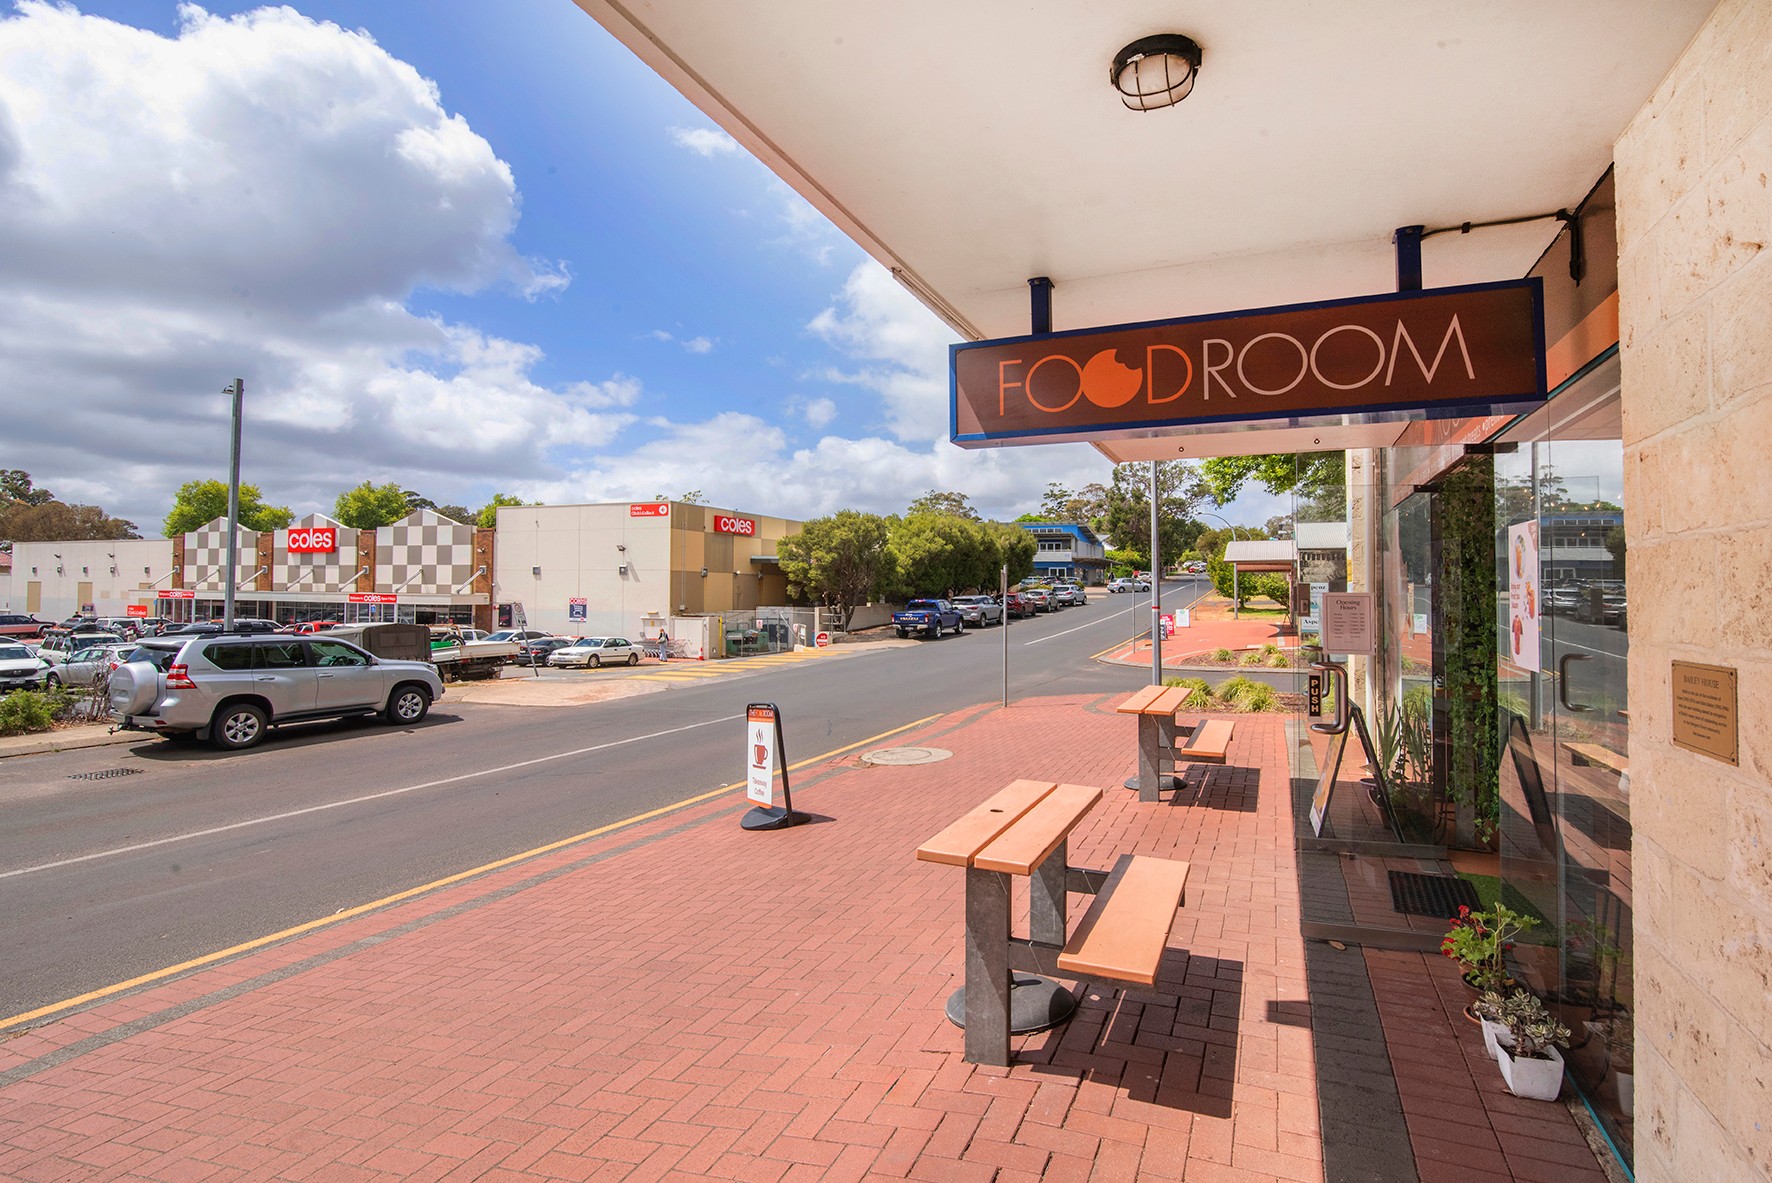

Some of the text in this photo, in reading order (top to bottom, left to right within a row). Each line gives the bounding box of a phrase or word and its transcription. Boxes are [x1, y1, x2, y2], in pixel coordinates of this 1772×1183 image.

[720, 517, 752, 534] coles
[289, 529, 332, 548] coles
[363, 594, 381, 602] coles
[1683, 675, 1720, 689] BAILEY HOUSE
[1311, 679, 1319, 713] PUSH
